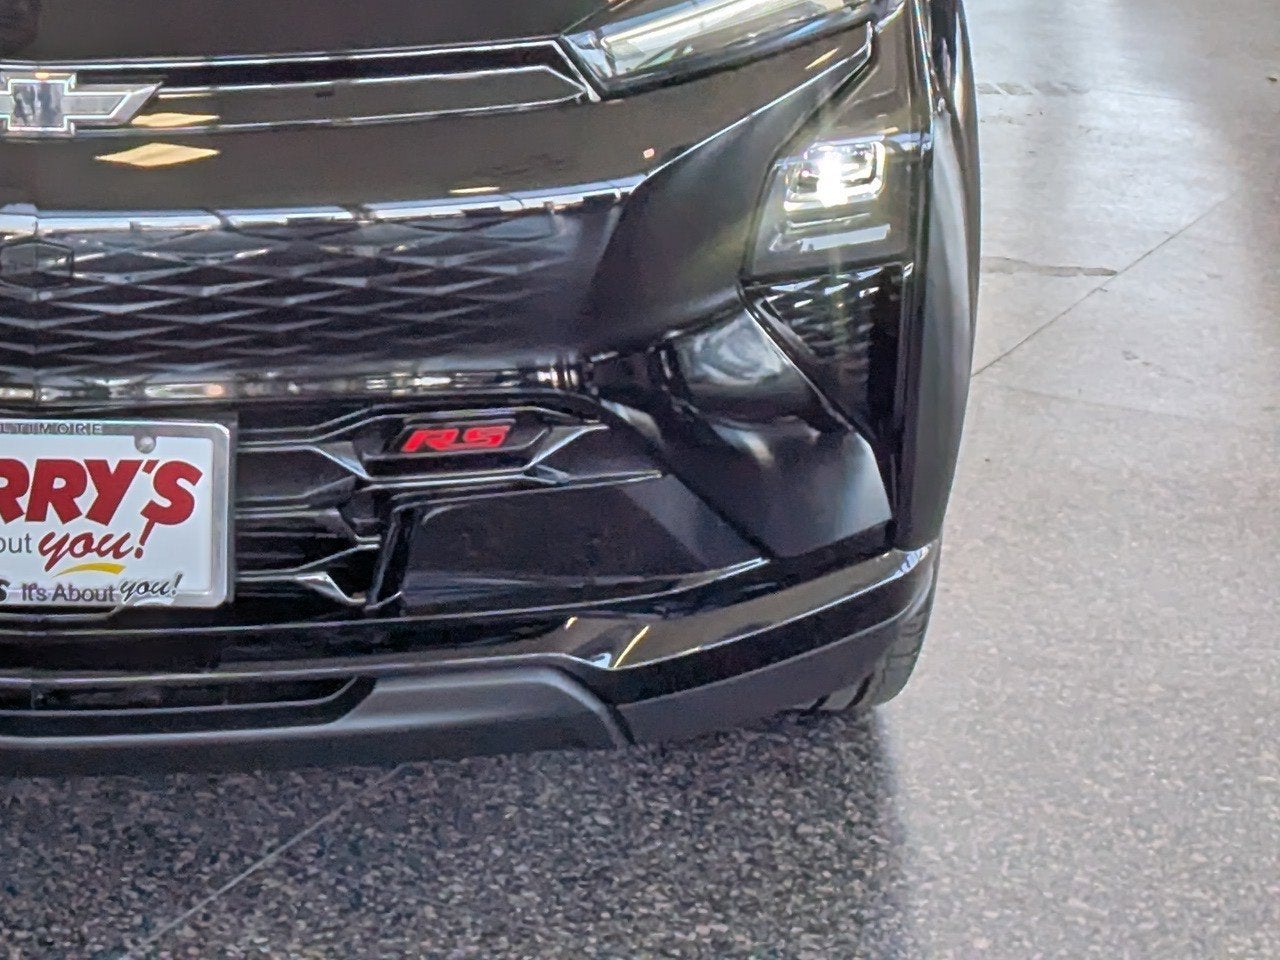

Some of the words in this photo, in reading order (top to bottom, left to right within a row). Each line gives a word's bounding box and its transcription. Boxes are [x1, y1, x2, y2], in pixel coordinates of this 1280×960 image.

[401, 424, 511, 452] RS
[37, 517, 155, 572] you!
[22, 583, 49, 601] It's
[54, 583, 118, 603] About
[122, 573, 184, 600] you!
